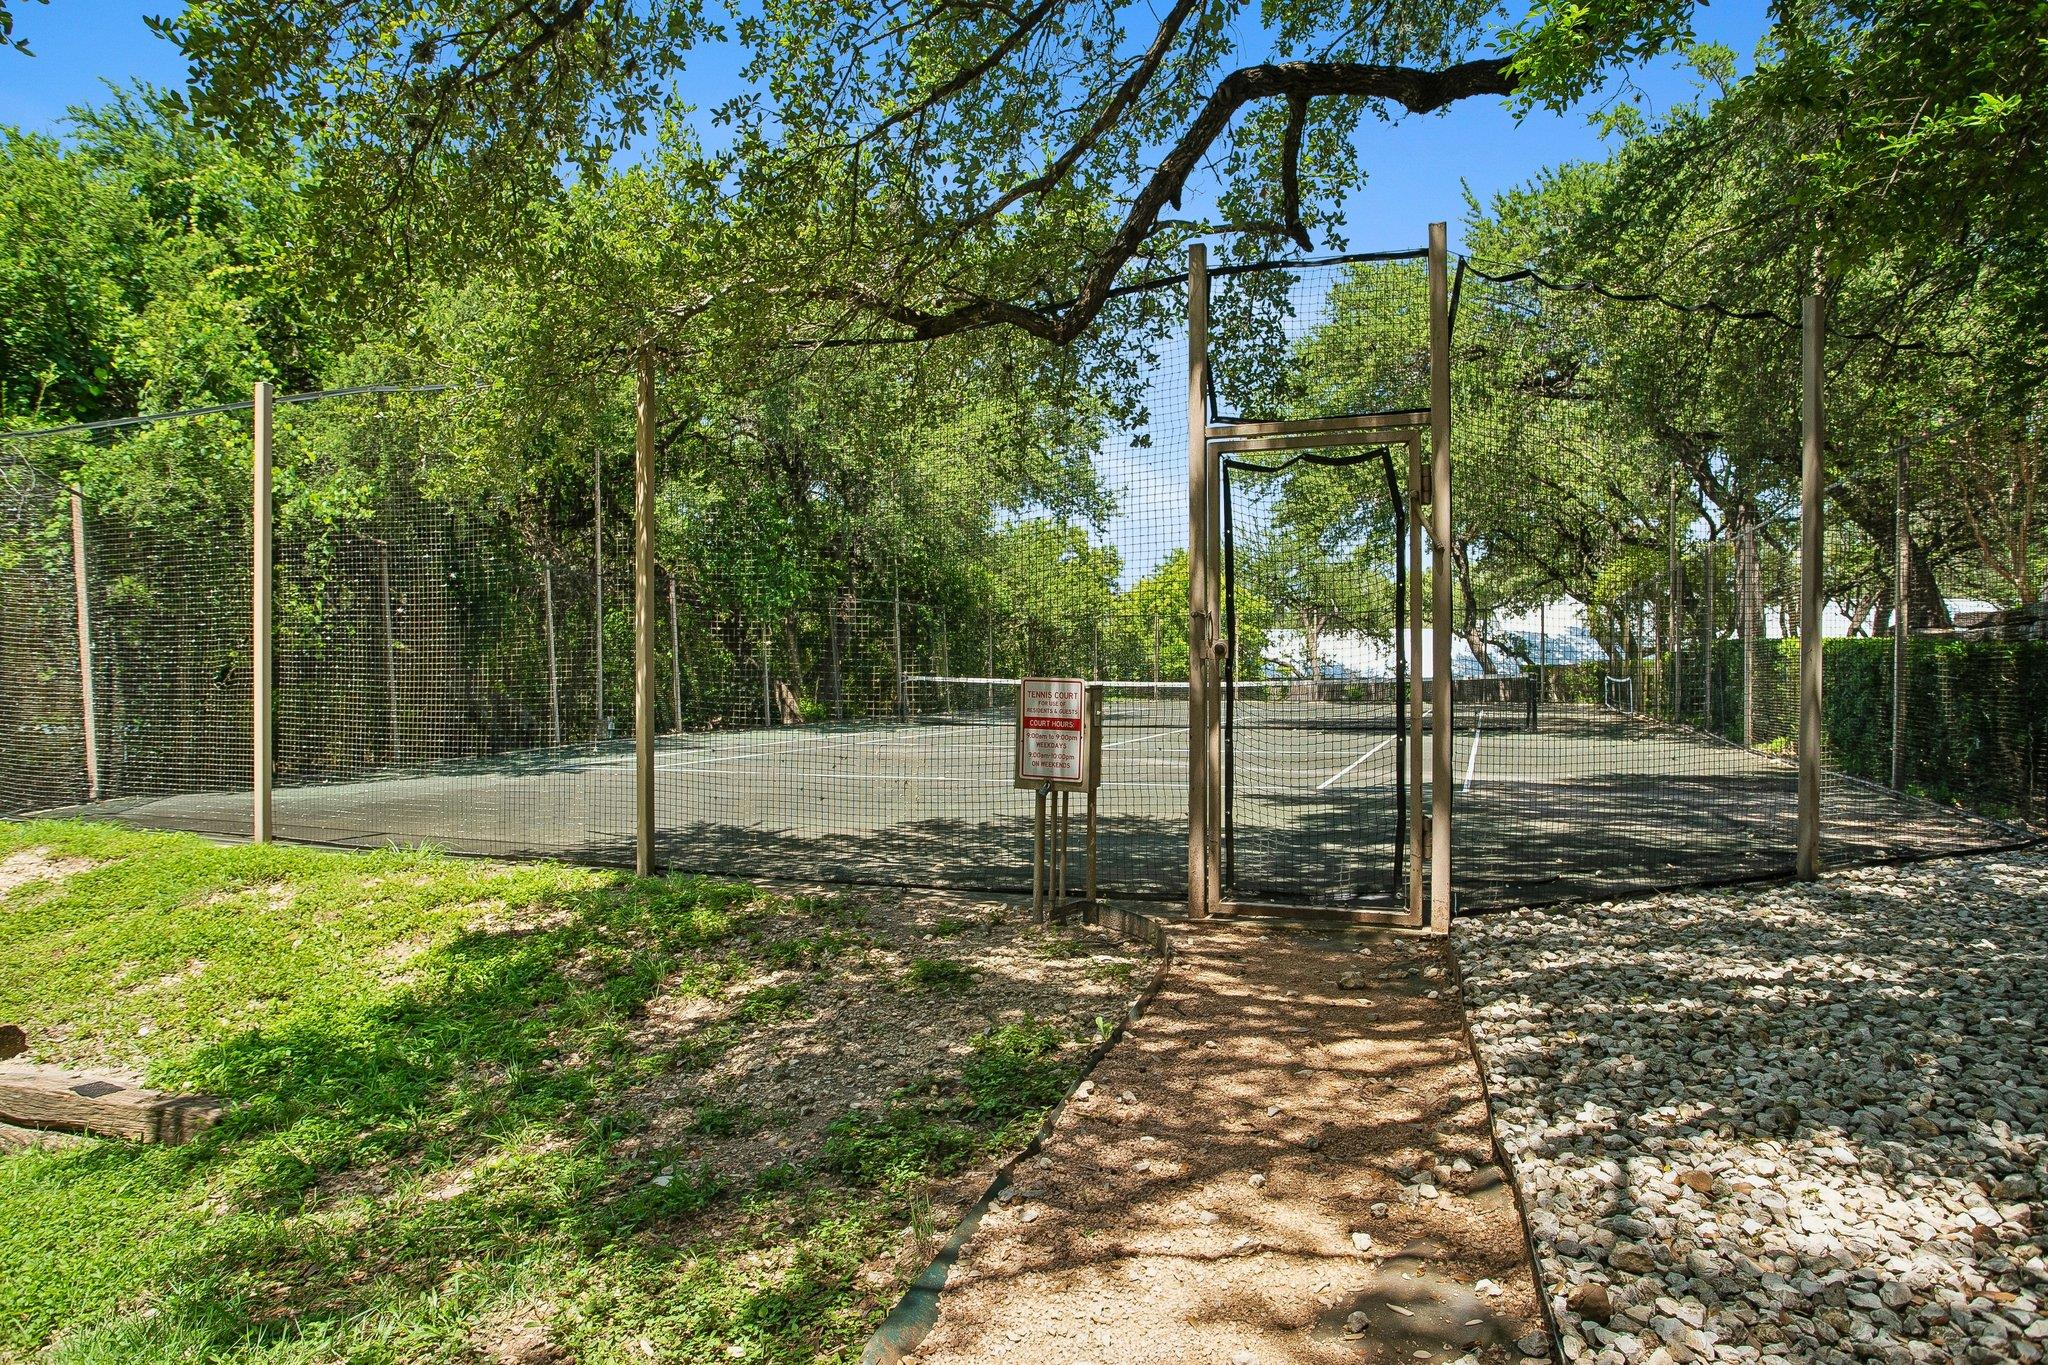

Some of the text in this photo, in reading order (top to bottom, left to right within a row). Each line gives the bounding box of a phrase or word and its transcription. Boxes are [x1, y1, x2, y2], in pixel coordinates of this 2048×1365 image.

[1027, 690, 1078, 700] TENNIS COURT
[1029, 719, 1074, 728] COURT HOURS:
[1026, 732, 1047, 740] 9:00am
